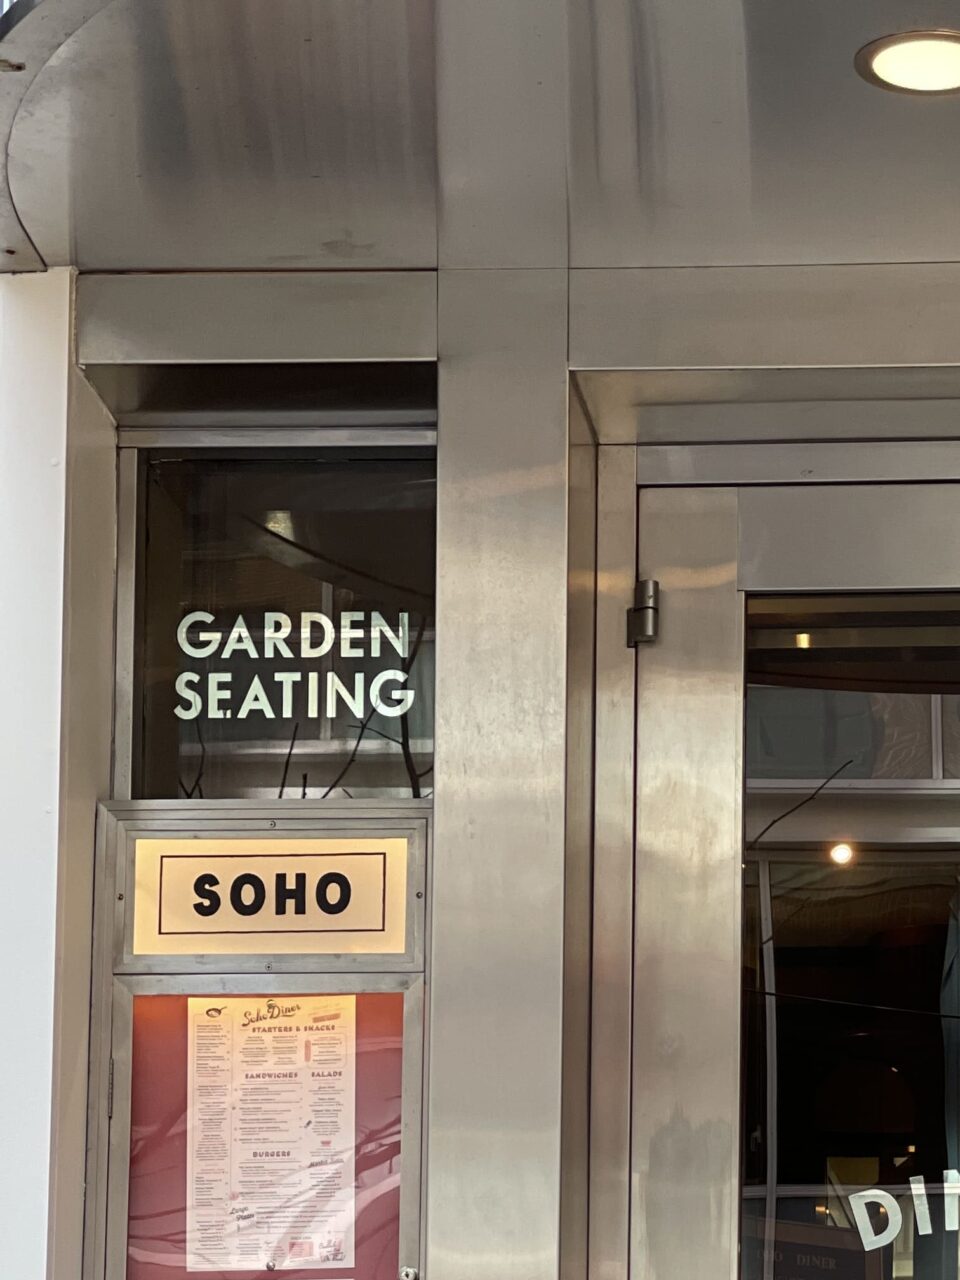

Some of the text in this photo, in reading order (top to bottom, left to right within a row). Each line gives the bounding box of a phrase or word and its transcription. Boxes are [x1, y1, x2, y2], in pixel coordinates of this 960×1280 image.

[177, 611, 410, 660] GARDEN
[173, 669, 416, 721] SEATING
[192, 871, 353, 917] SOHO
[242, 1008, 267, 1027] Soho
[245, 1071, 298, 1080] SANDWICHES
[796, 1253, 838, 1270] DINER
